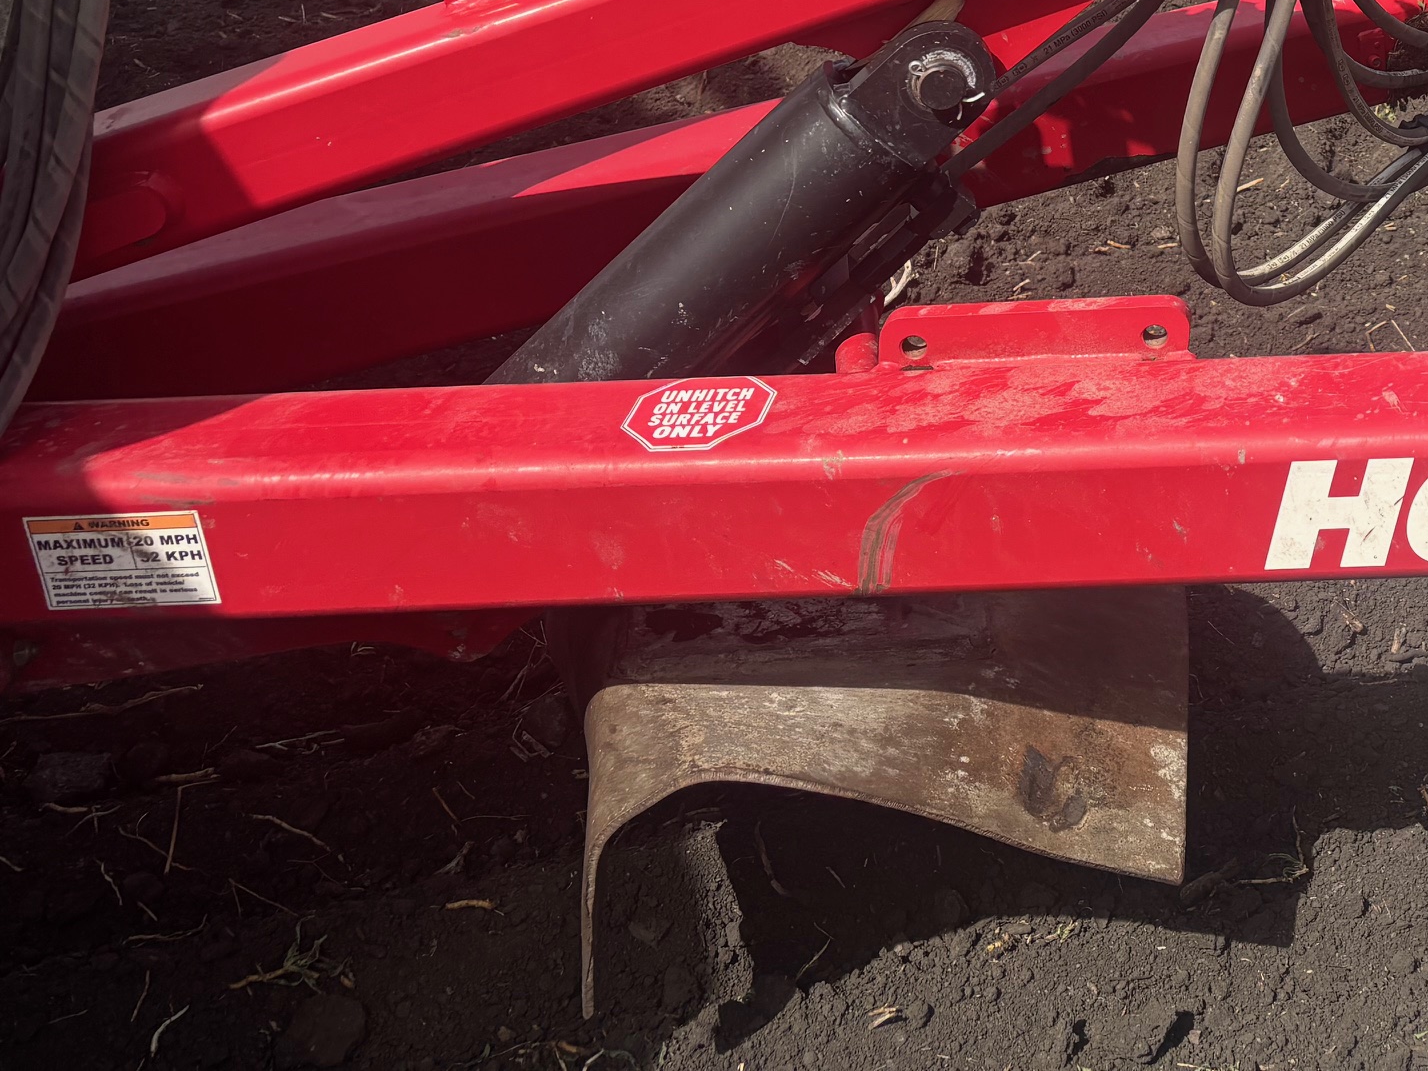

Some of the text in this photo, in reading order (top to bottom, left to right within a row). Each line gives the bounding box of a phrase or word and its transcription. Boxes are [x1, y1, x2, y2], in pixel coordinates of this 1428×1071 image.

[1043, 45, 1053, 55] 21
[1053, 34, 1071, 48] MPa
[661, 387, 755, 403] UNHITCH
[653, 400, 746, 414] ON LEVEL
[648, 412, 741, 426] SURFACE
[652, 424, 722, 439] ONLY
[88, 518, 150, 529] WARNING
[37, 533, 199, 551] MAXIMUM 20 MPH
[57, 553, 114, 566] SPEED
[165, 550, 203, 562] KPH
